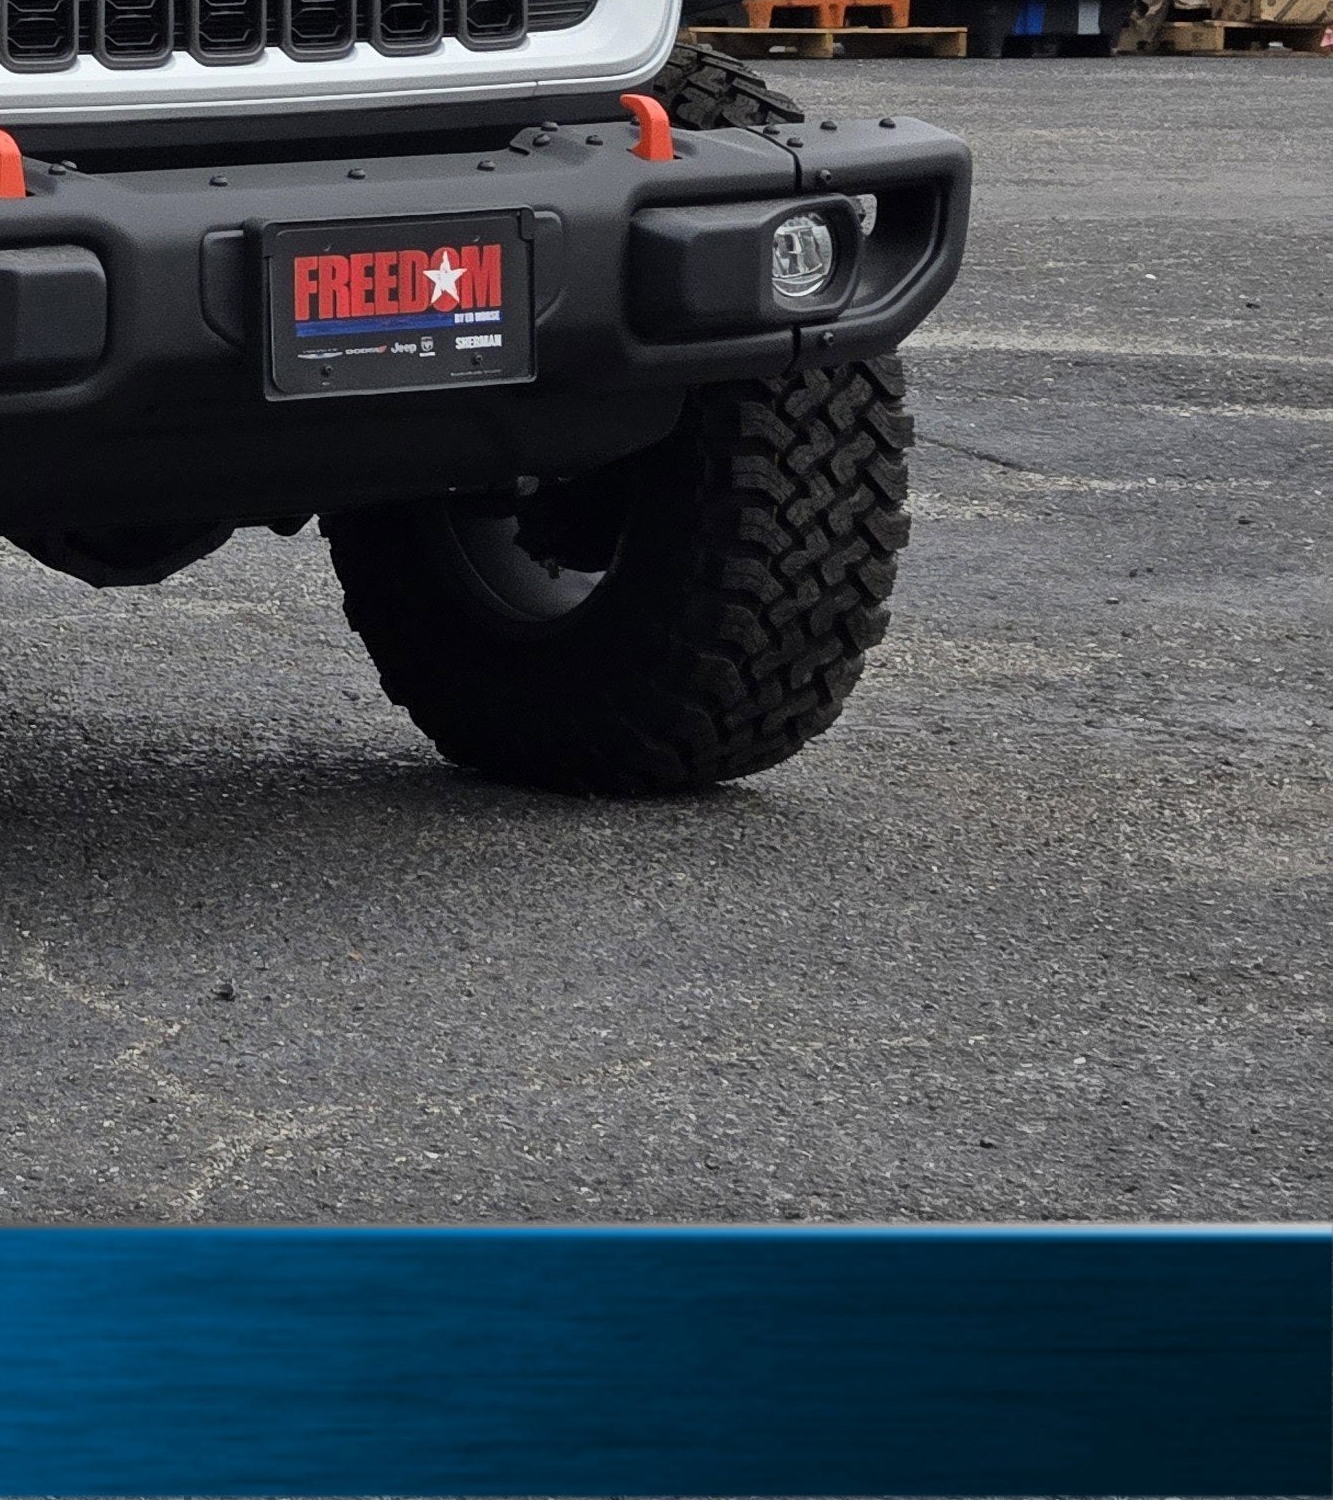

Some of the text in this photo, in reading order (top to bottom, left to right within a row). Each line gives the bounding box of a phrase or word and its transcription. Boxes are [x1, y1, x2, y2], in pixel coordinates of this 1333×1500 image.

[294, 244, 502, 321] FREEDOM
[391, 342, 417, 354] Jeep
[455, 334, 502, 350] SHERMAN
